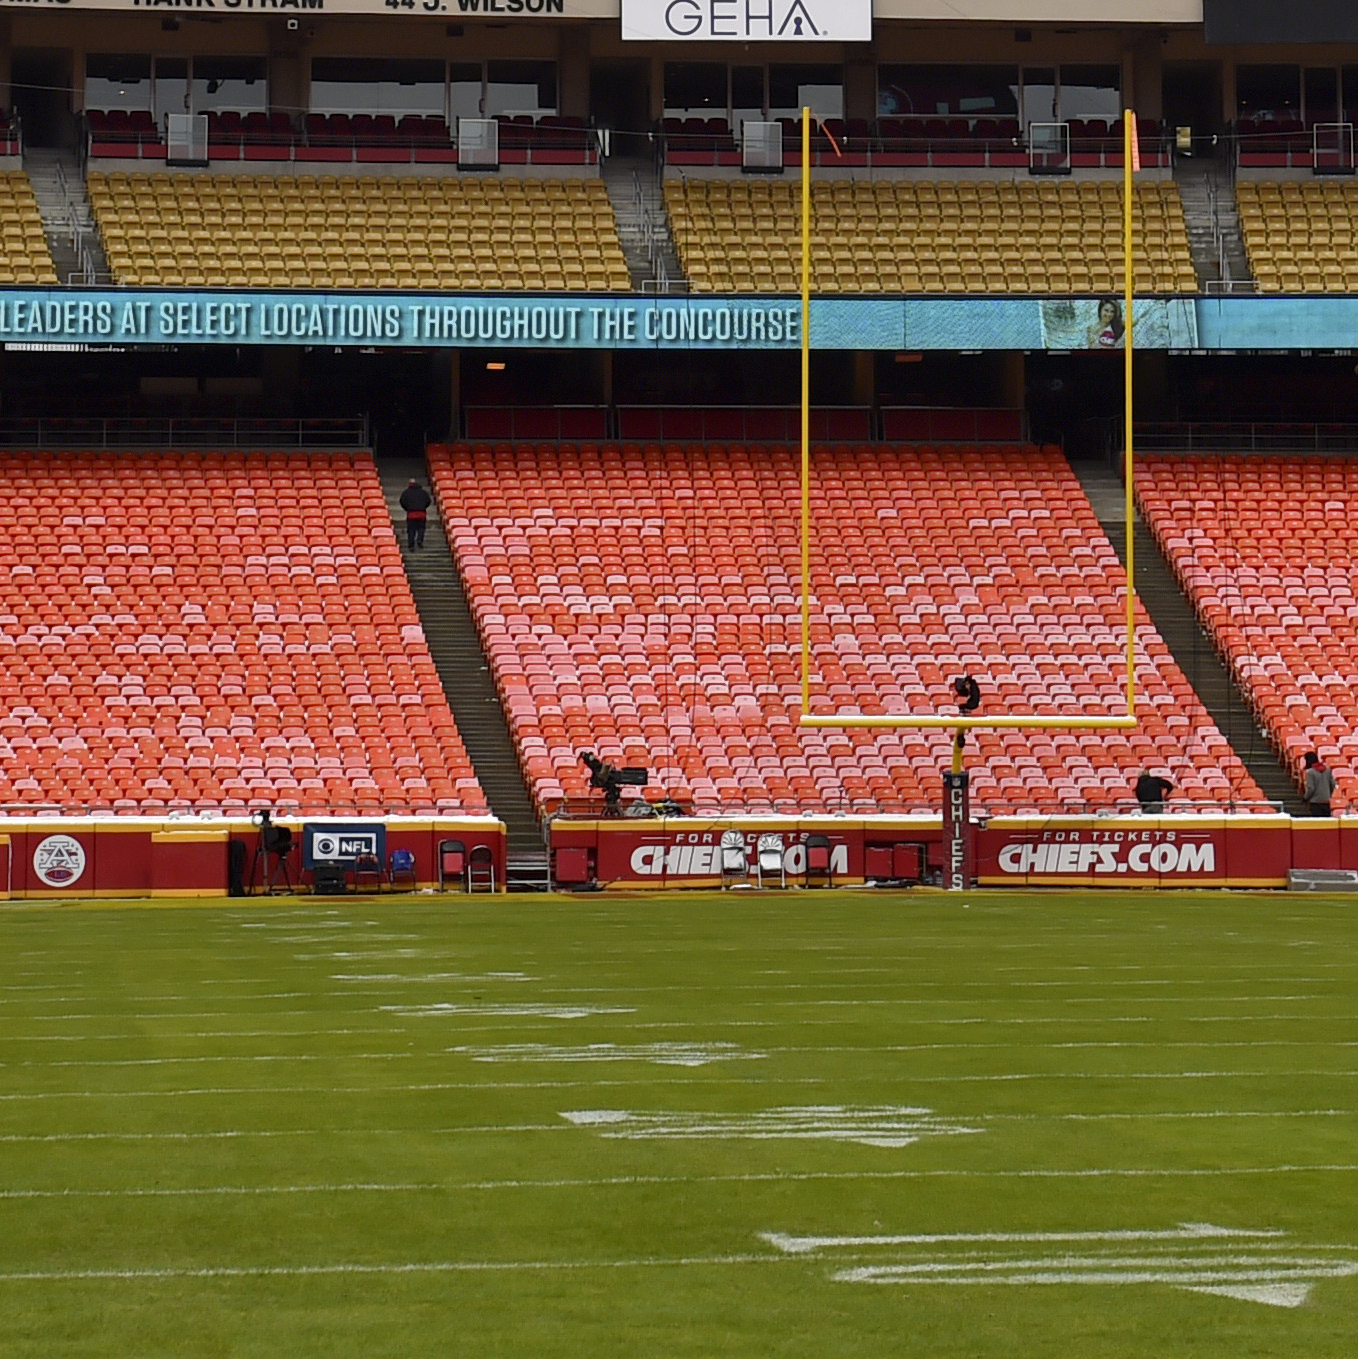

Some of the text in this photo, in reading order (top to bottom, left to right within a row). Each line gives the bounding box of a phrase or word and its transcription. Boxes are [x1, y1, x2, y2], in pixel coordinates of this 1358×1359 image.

[121, 300, 150, 335] AT
[158, 302, 252, 337] SELECT
[259, 303, 401, 339] LOCATIONS
[408, 306, 583, 340] THROUGHOUT
[589, 307, 635, 341] THE
[643, 307, 799, 341] CONCOURSE
[341, 840, 371, 853] NFL
[676, 833, 713, 844] FOR
[950, 788, 964, 891] CHIEFS
[1042, 831, 1177, 842] FOR TICKETS
[998, 843, 1215, 873] CHIEFS.COM
